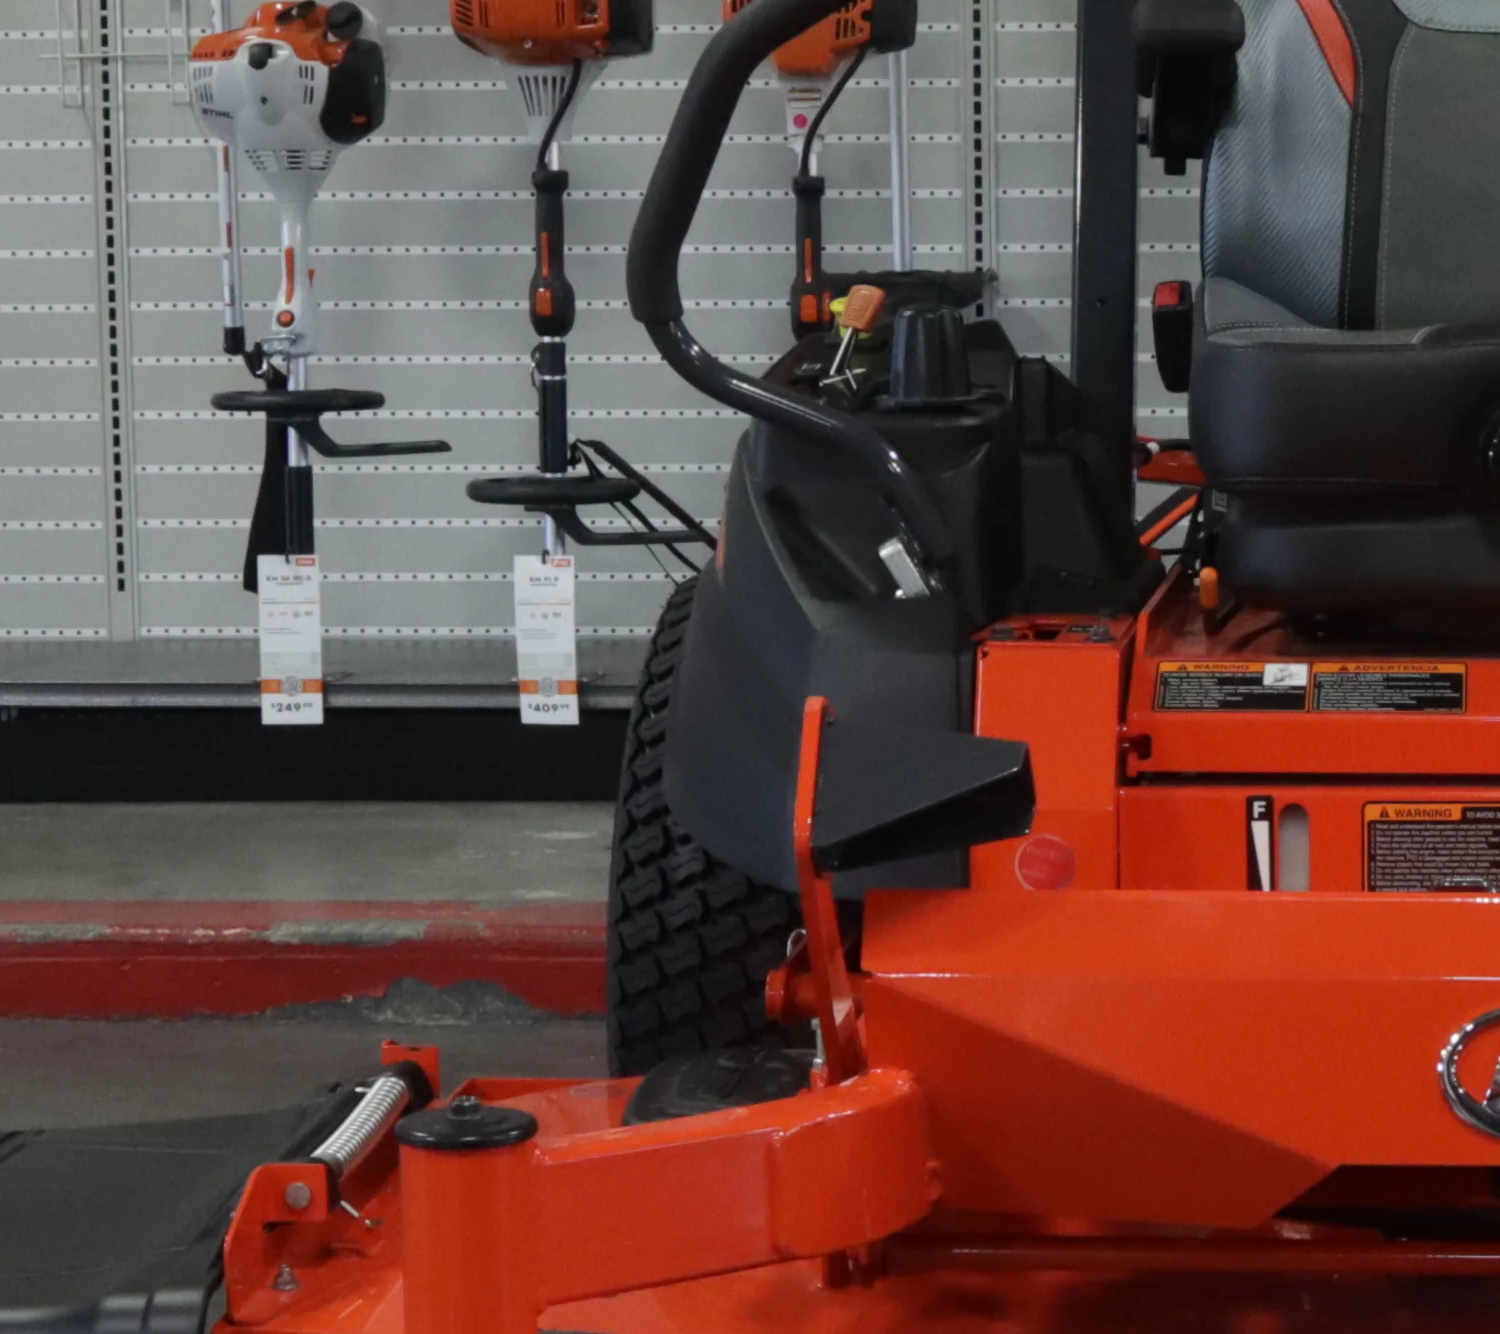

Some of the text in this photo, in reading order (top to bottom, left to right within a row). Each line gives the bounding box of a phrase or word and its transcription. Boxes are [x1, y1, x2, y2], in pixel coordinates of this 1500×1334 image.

[201, 107, 235, 120] STIHL
[1355, 664, 1440, 672] ADVERTENCIA
[1252, 801, 1267, 820] F
[1393, 808, 1453, 819] WARNING
[1476, 811, 1496, 819] AVOID
